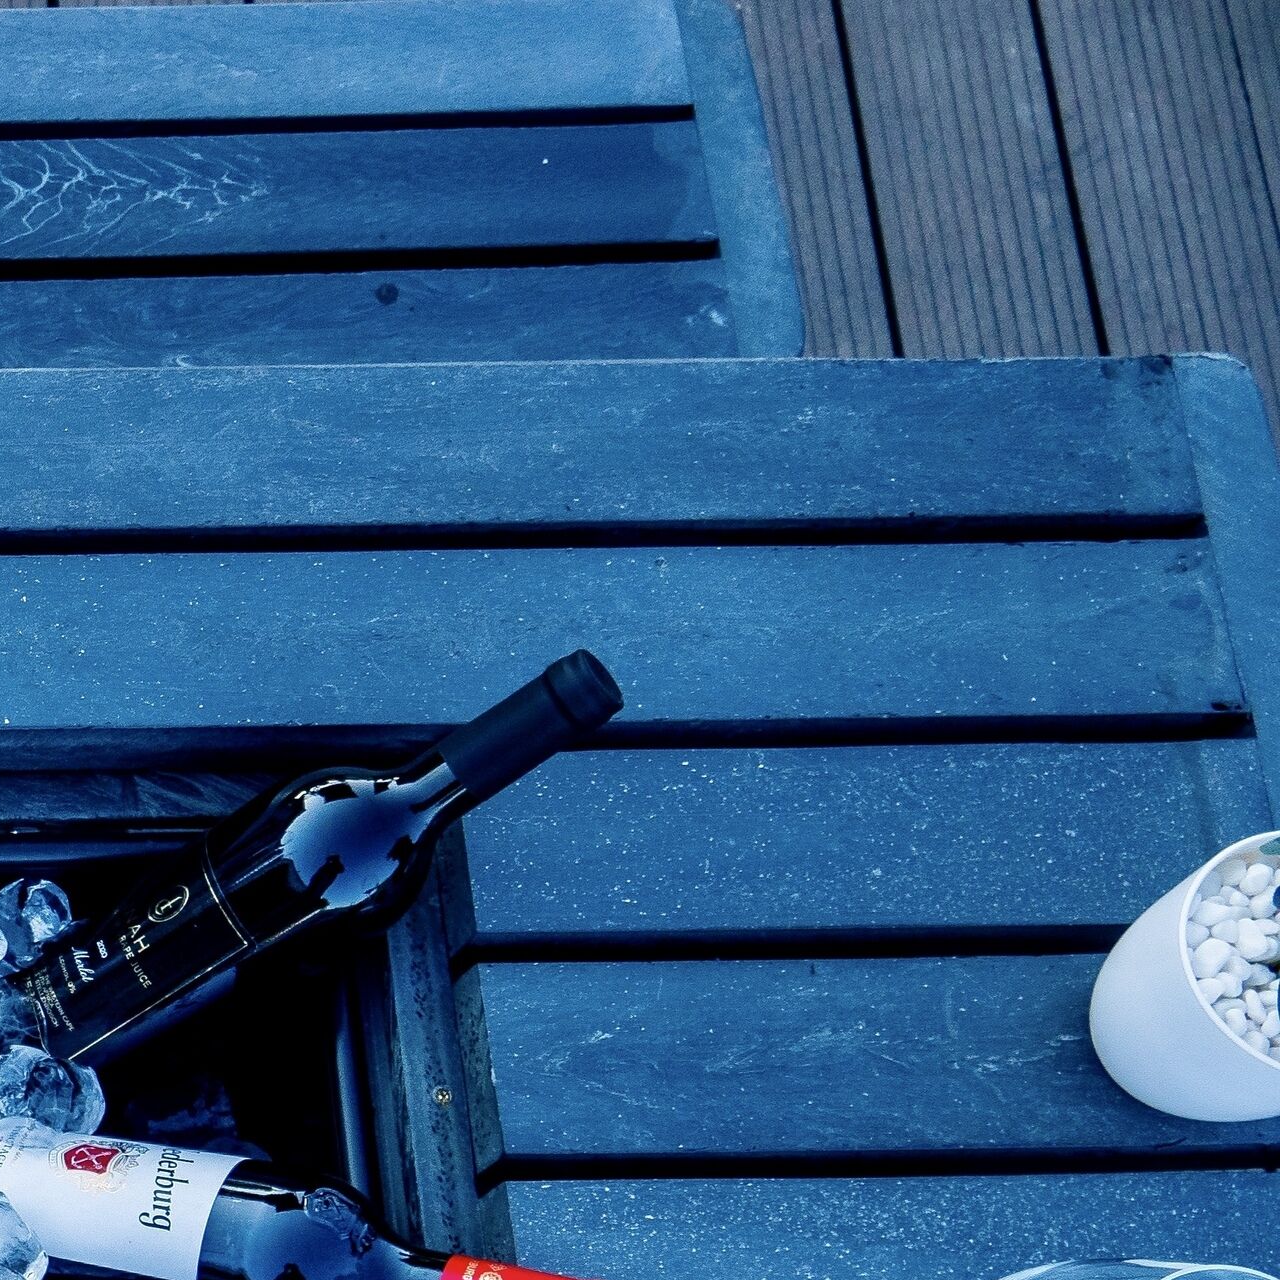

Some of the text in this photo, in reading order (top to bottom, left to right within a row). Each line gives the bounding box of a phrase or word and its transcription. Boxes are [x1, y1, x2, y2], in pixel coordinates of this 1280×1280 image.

[71, 946, 95, 983] Merlot
[130, 961, 152, 989] JUICE
[138, 1148, 194, 1231] ederburg
